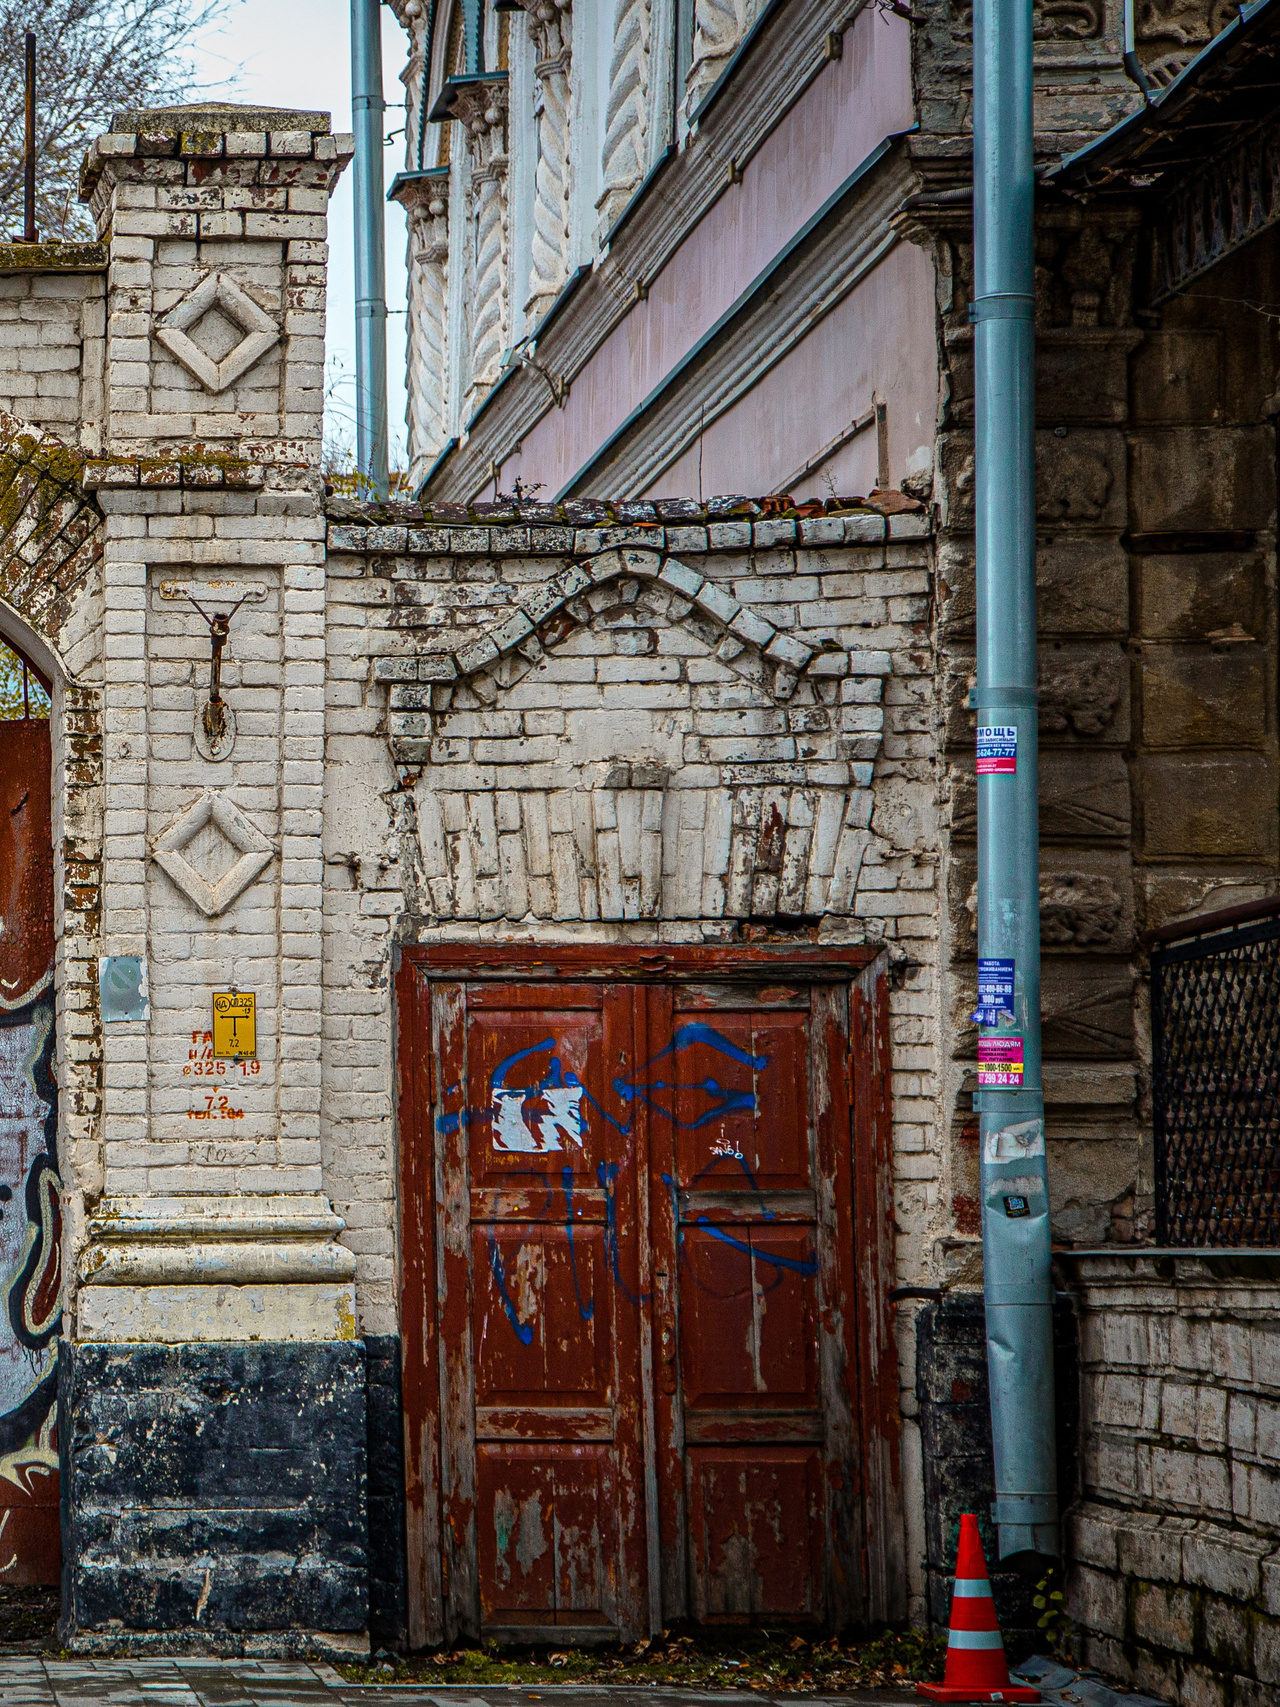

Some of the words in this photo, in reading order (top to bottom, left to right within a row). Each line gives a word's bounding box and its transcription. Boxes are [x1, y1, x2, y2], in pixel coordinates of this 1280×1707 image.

[192, 1030, 214, 1044] ГА
[992, 1040, 1021, 1048] ЛЮДЯМ
[997, 1073, 1008, 1084] 24
[1009, 1073, 1021, 1085] 24
